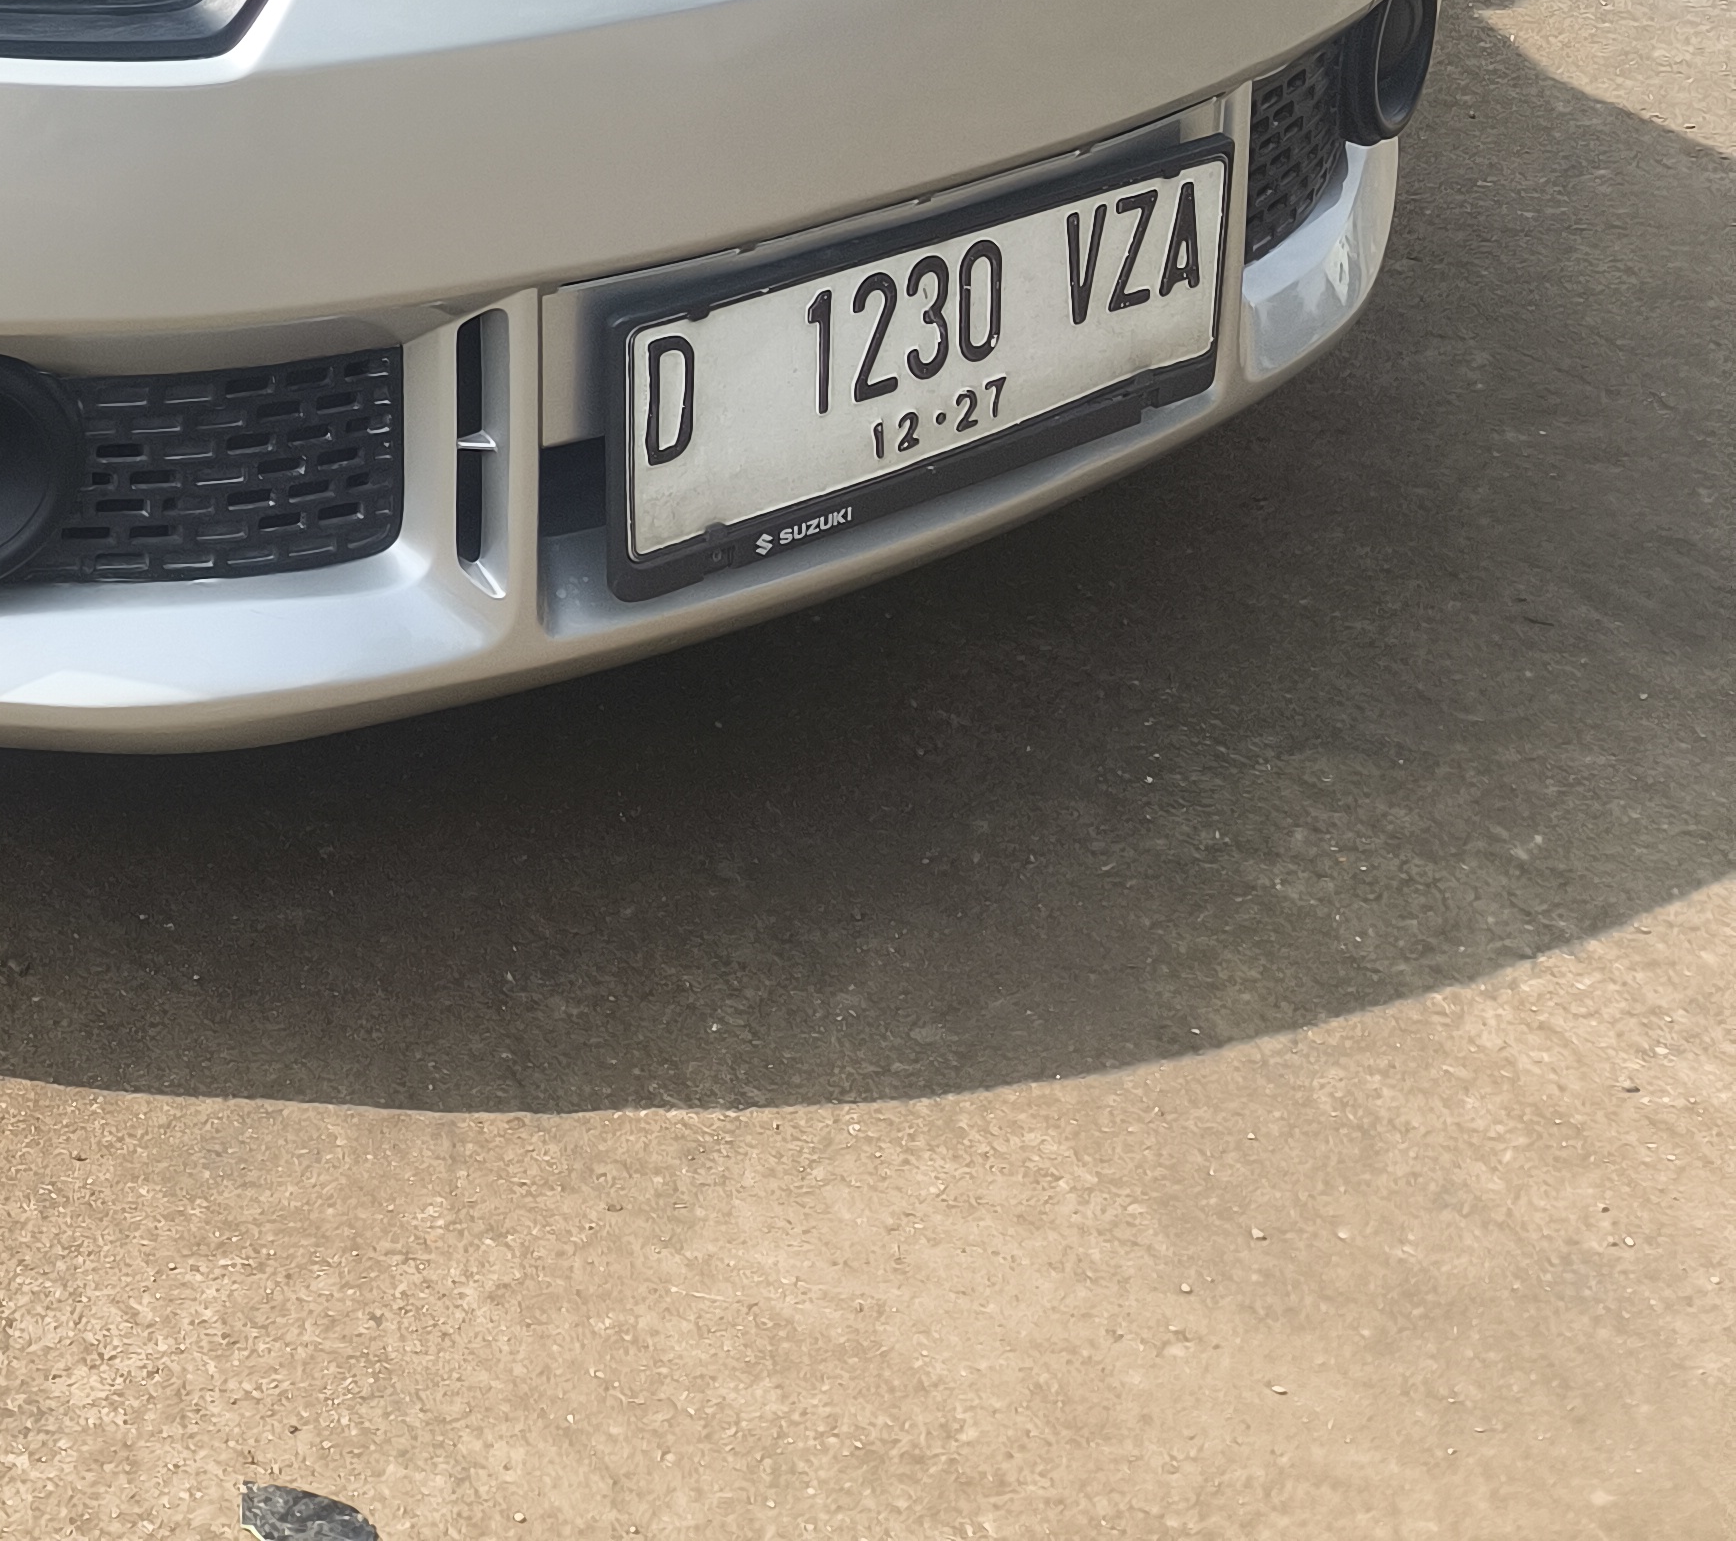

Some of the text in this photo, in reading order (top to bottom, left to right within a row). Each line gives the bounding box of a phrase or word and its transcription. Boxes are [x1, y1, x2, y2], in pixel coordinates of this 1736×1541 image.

[643, 181, 1201, 466] D 1230 VZA
[779, 506, 853, 545] SUZUKI
